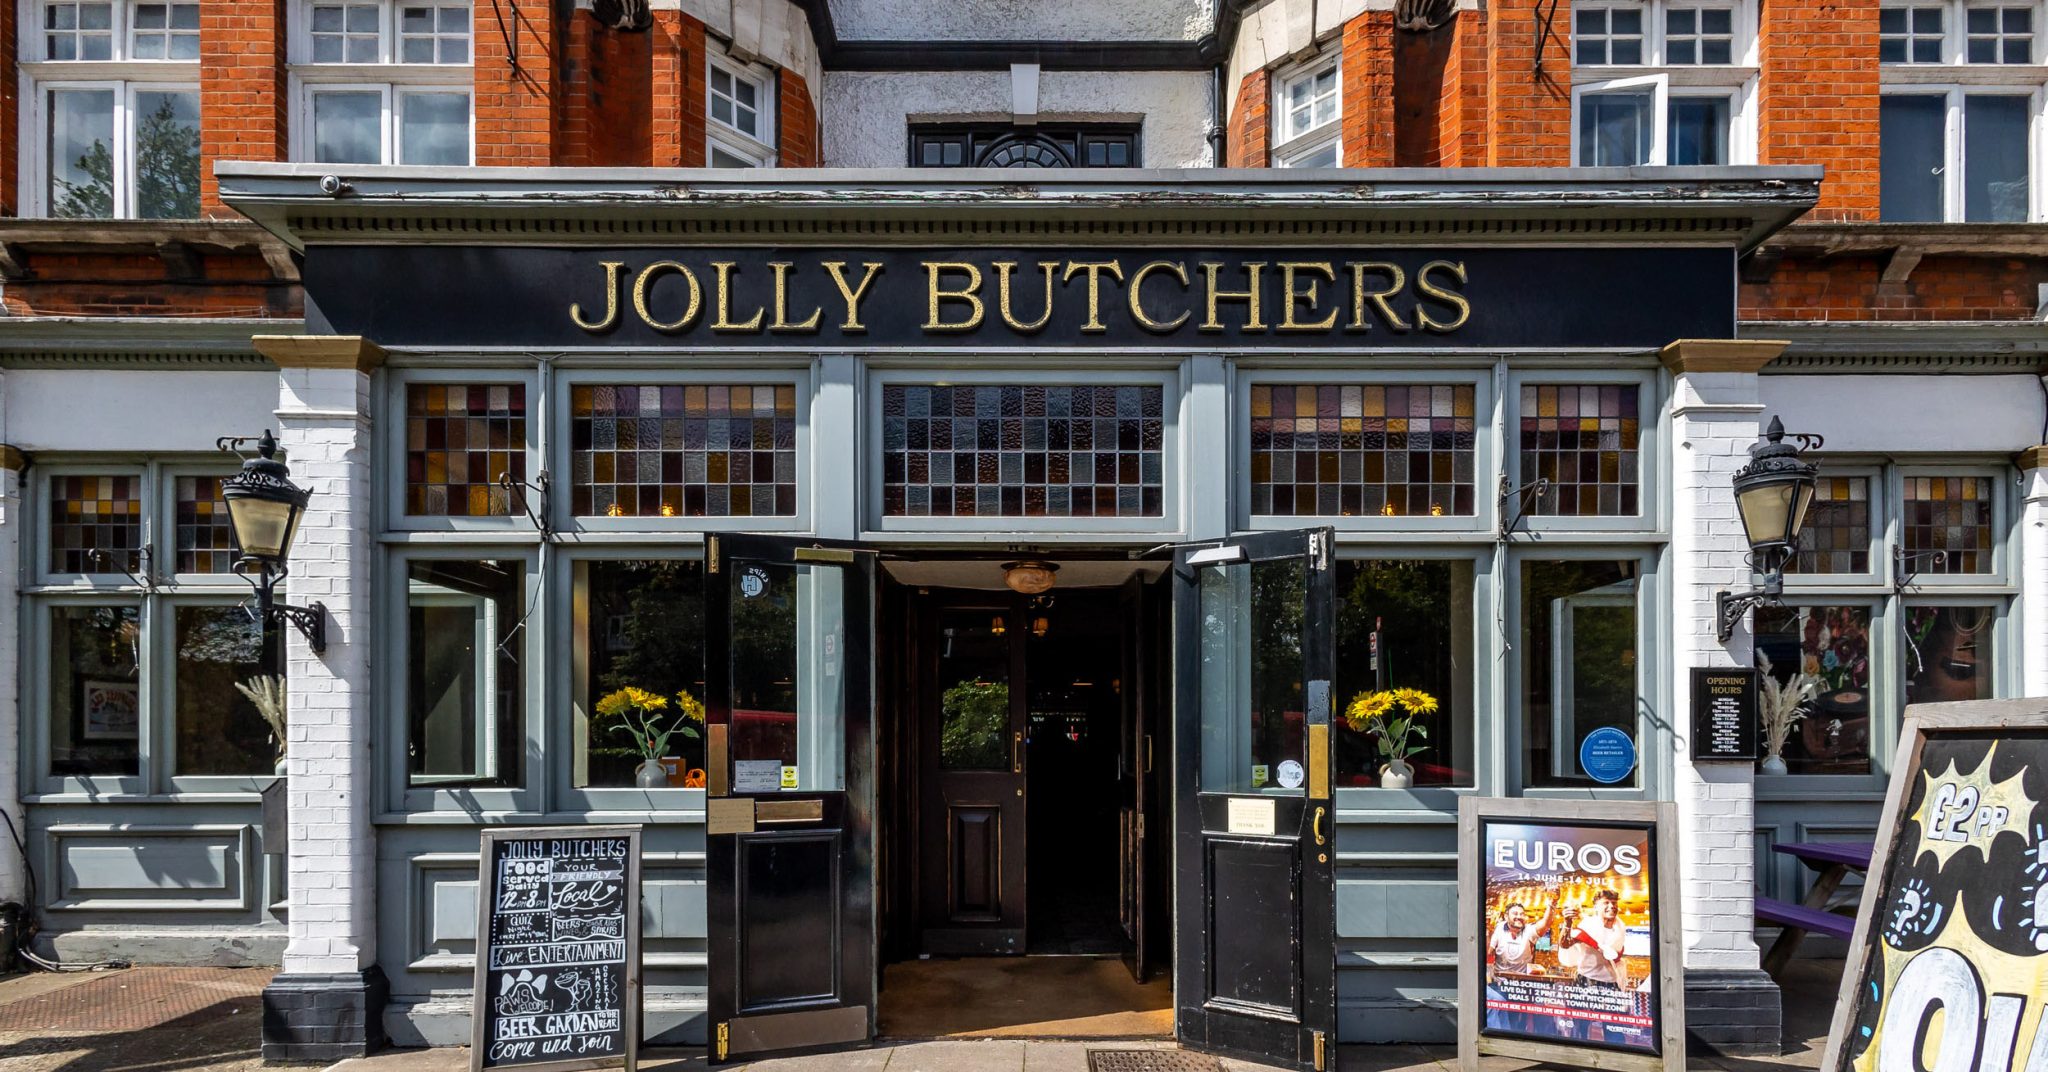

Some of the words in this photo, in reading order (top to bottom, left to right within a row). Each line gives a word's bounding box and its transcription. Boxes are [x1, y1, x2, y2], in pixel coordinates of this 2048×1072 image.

[569, 260, 884, 331] JOLLY
[920, 260, 1471, 332] BUTCHERS
[1706, 677, 1746, 685] OPENING
[1711, 686, 1742, 694] HOURS
[501, 841, 543, 859] JOLLY
[552, 840, 626, 858] BUTCHERS
[1494, 838, 1642, 876] EUROS
[564, 863, 599, 872] YOUR
[561, 871, 612, 881] FRIENDLY
[1518, 873, 1530, 881] 14
[552, 881, 608, 909] Local
[510, 916, 533, 926] QUIZ
[528, 942, 622, 963] ENTERTAINMENT
[1521, 981, 1550, 989] SCREENS
[1564, 985, 1599, 995] OUTDOOR
[494, 989, 530, 1013] PAWS
[1567, 1000, 1588, 1008] TOWN
[1570, 993, 1588, 1001] PINT
[499, 1017, 541, 1039] BEER
[546, 1013, 598, 1034] GARDEN
[490, 1041, 535, 1060] Come
[543, 1035, 573, 1053] and
